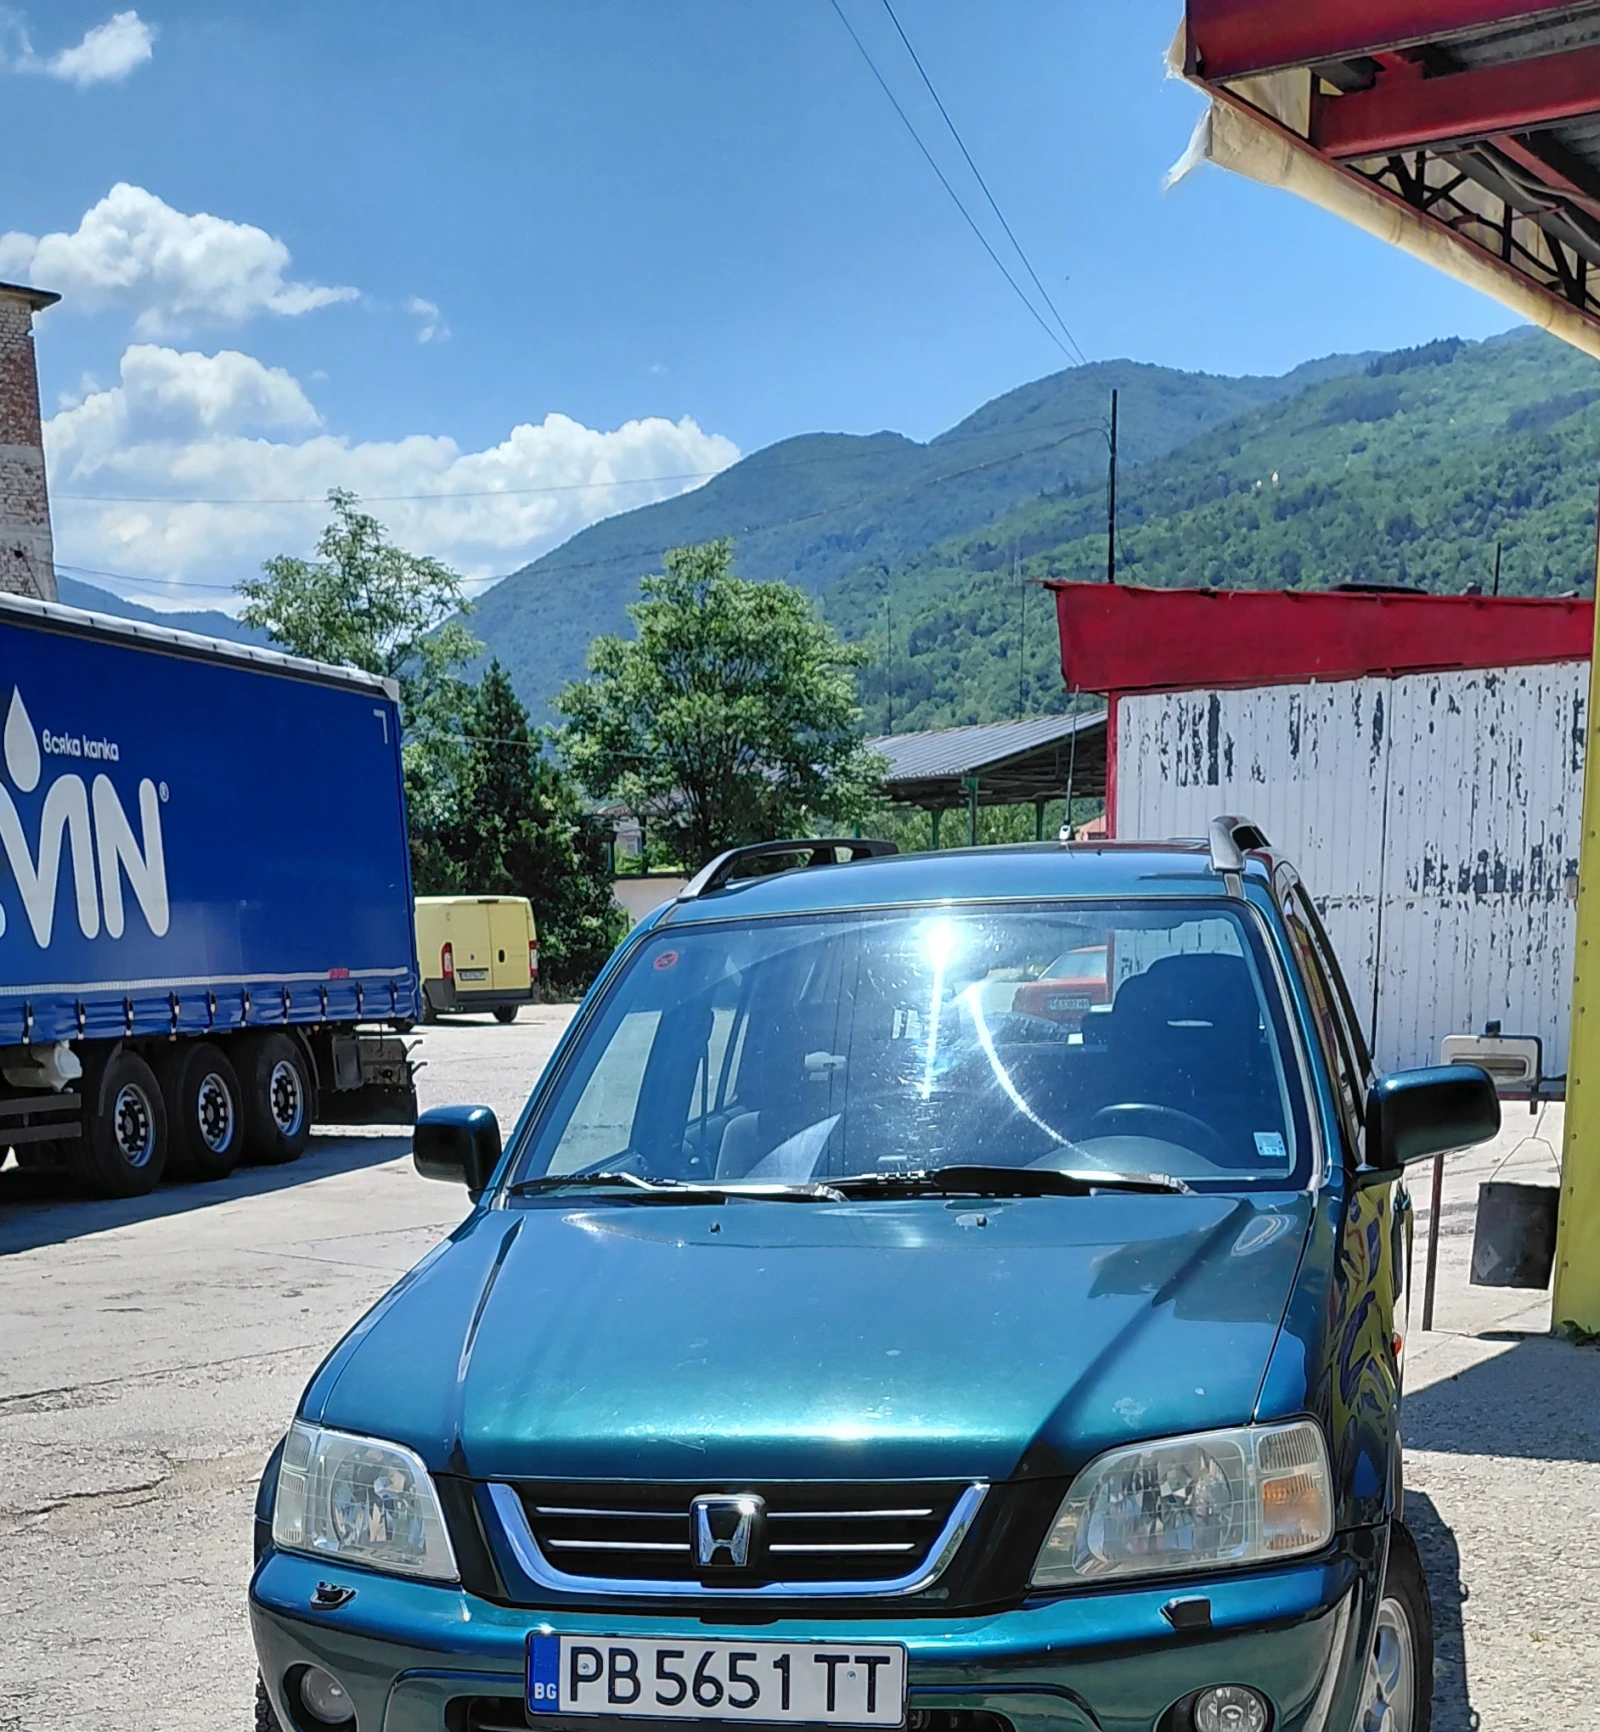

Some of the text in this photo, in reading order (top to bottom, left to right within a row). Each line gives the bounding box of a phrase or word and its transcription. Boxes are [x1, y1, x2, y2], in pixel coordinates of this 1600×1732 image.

[83, 734, 119, 761] капка
[0, 774, 169, 949] VIN
[534, 1682, 557, 1699] BG
[570, 1646, 891, 1713] PB 5651 TT
